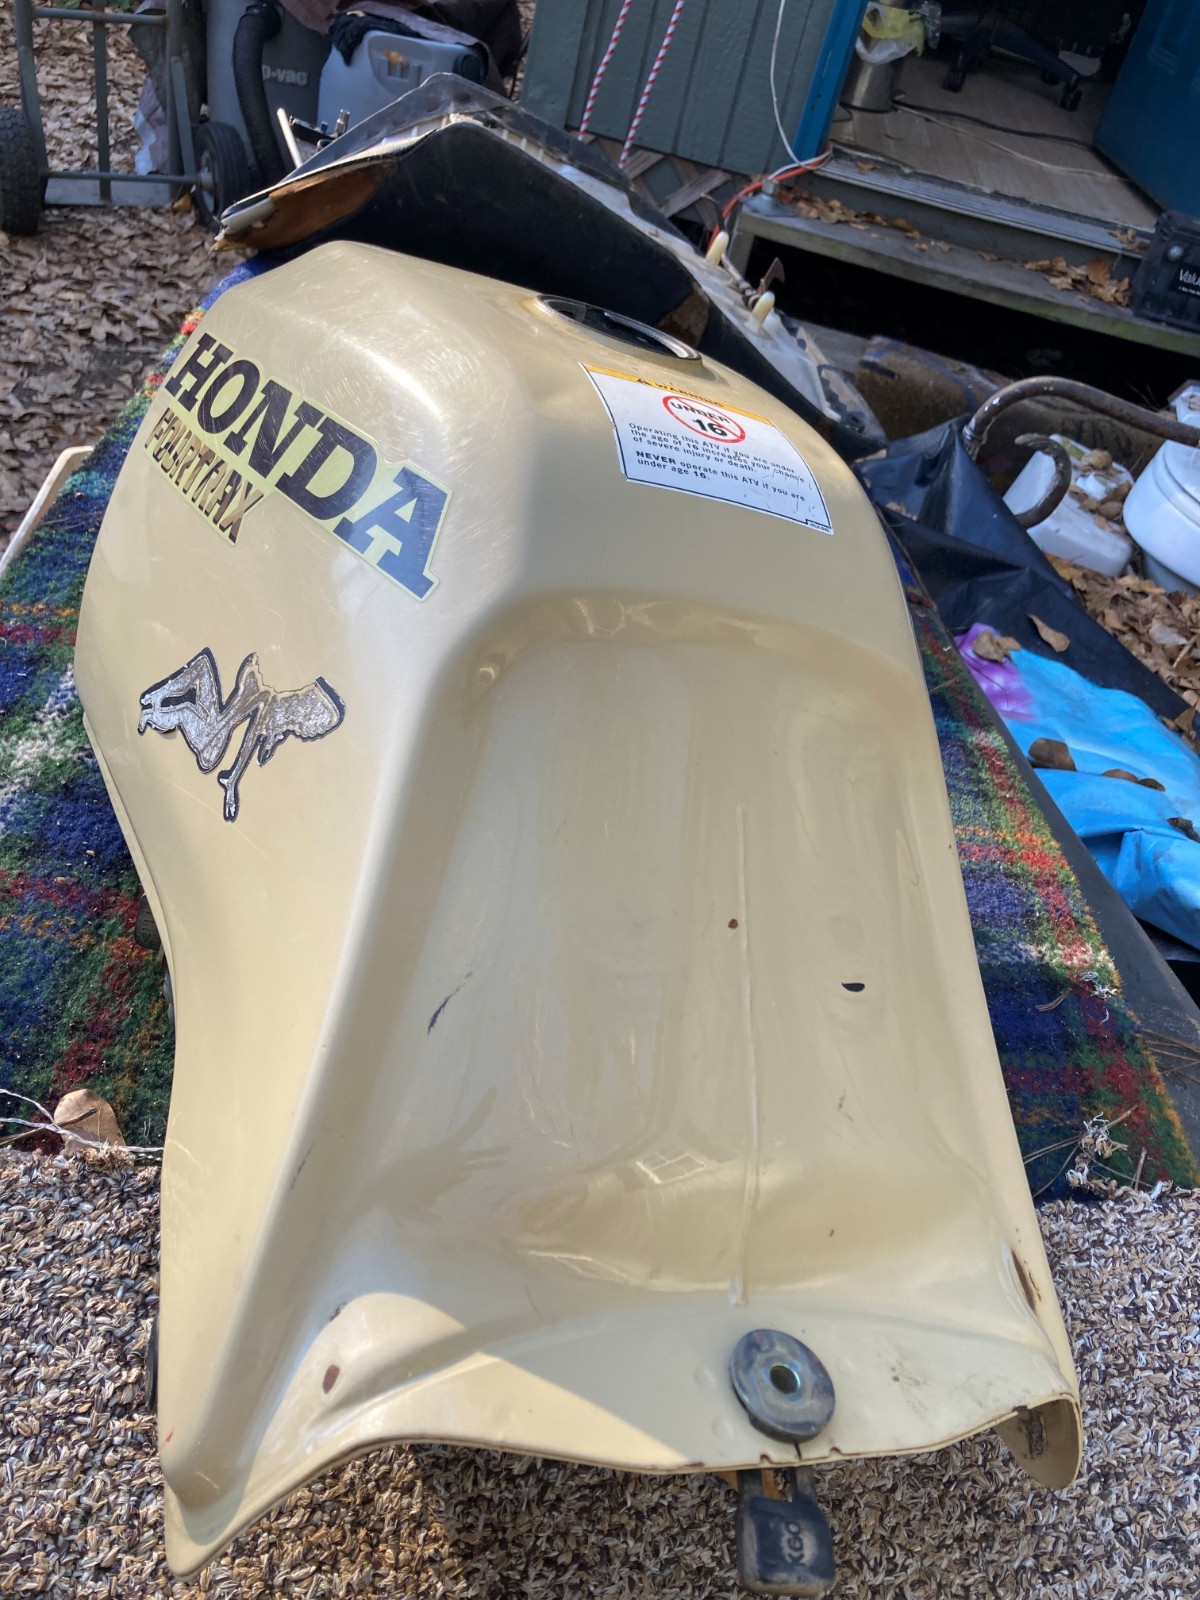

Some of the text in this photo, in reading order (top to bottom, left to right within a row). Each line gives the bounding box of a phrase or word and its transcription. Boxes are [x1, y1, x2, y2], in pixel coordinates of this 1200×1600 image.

[671, 401, 731, 424] UNDER
[692, 418, 728, 437] 16
[164, 332, 449, 599] HONDA
[629, 423, 679, 440] Operating
[682, 434, 699, 445] this
[703, 441, 720, 450] ATV
[735, 450, 750, 459] you
[753, 456, 768, 464] are
[770, 462, 795, 473] under
[631, 429, 647, 439] the
[651, 435, 669, 444] age
[702, 446, 748, 464] increases
[751, 461, 770, 471] your
[774, 468, 805, 483] chance
[637, 459, 710, 480] under age 16.
[646, 440, 680, 451] severe
[684, 447, 711, 461] injury
[728, 459, 757, 473] death.
[144, 407, 264, 544] FOURTRAX
[636, 450, 676, 465] NEVER
[680, 461, 718, 475] operate
[721, 469, 738, 480] this
[742, 476, 759, 486] ATV
[772, 486, 788, 496] you
[791, 493, 805, 501] are
